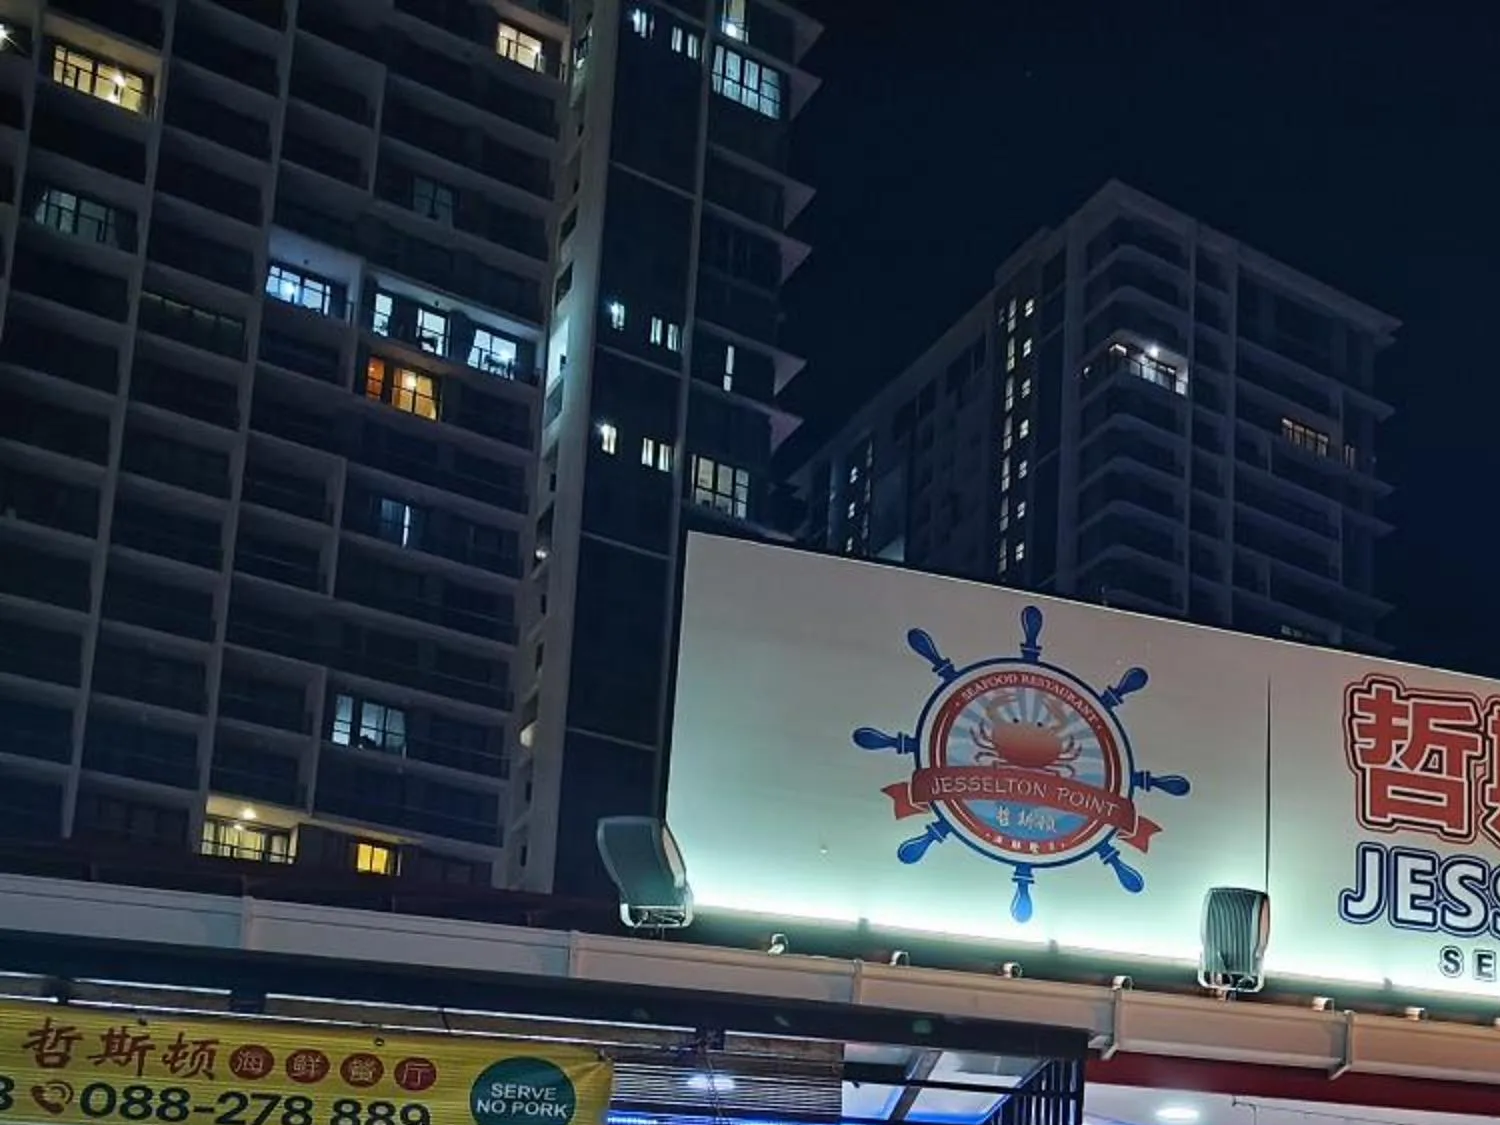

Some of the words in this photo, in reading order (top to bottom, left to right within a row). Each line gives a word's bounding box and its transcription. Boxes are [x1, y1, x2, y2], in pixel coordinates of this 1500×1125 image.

[961, 673, 1018, 701] SEAFOOD
[1020, 673, 1099, 724] RESTAURANT
[930, 776, 1047, 799] JESSELTON
[1057, 787, 1121, 818] POINT
[23, 1018, 219, 1079] 哲斯顿
[477, 1099, 507, 1116] NO
[512, 1101, 568, 1119] PORK
[491, 1083, 557, 1102] SERVE
